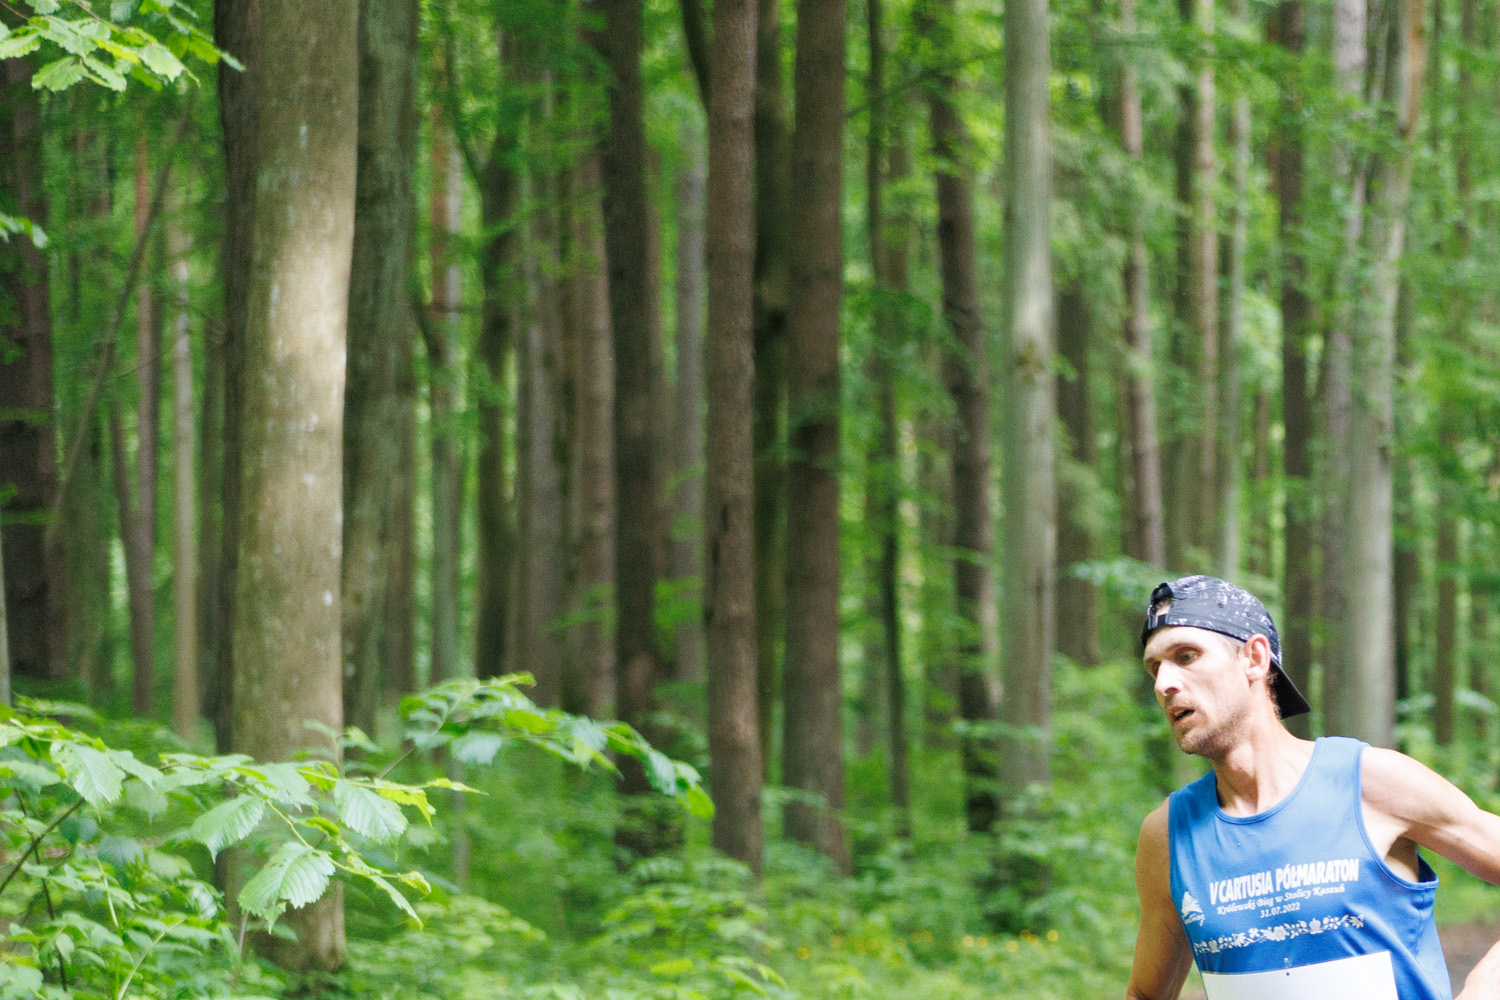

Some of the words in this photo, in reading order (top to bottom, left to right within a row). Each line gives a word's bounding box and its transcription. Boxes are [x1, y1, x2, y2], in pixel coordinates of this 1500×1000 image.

[1209, 882, 1219, 905] V
[1219, 871, 1274, 902] CARTUSIA
[1275, 858, 1360, 892] PÓŁMARATON
[1260, 902, 1301, 918] 31.07.2022
